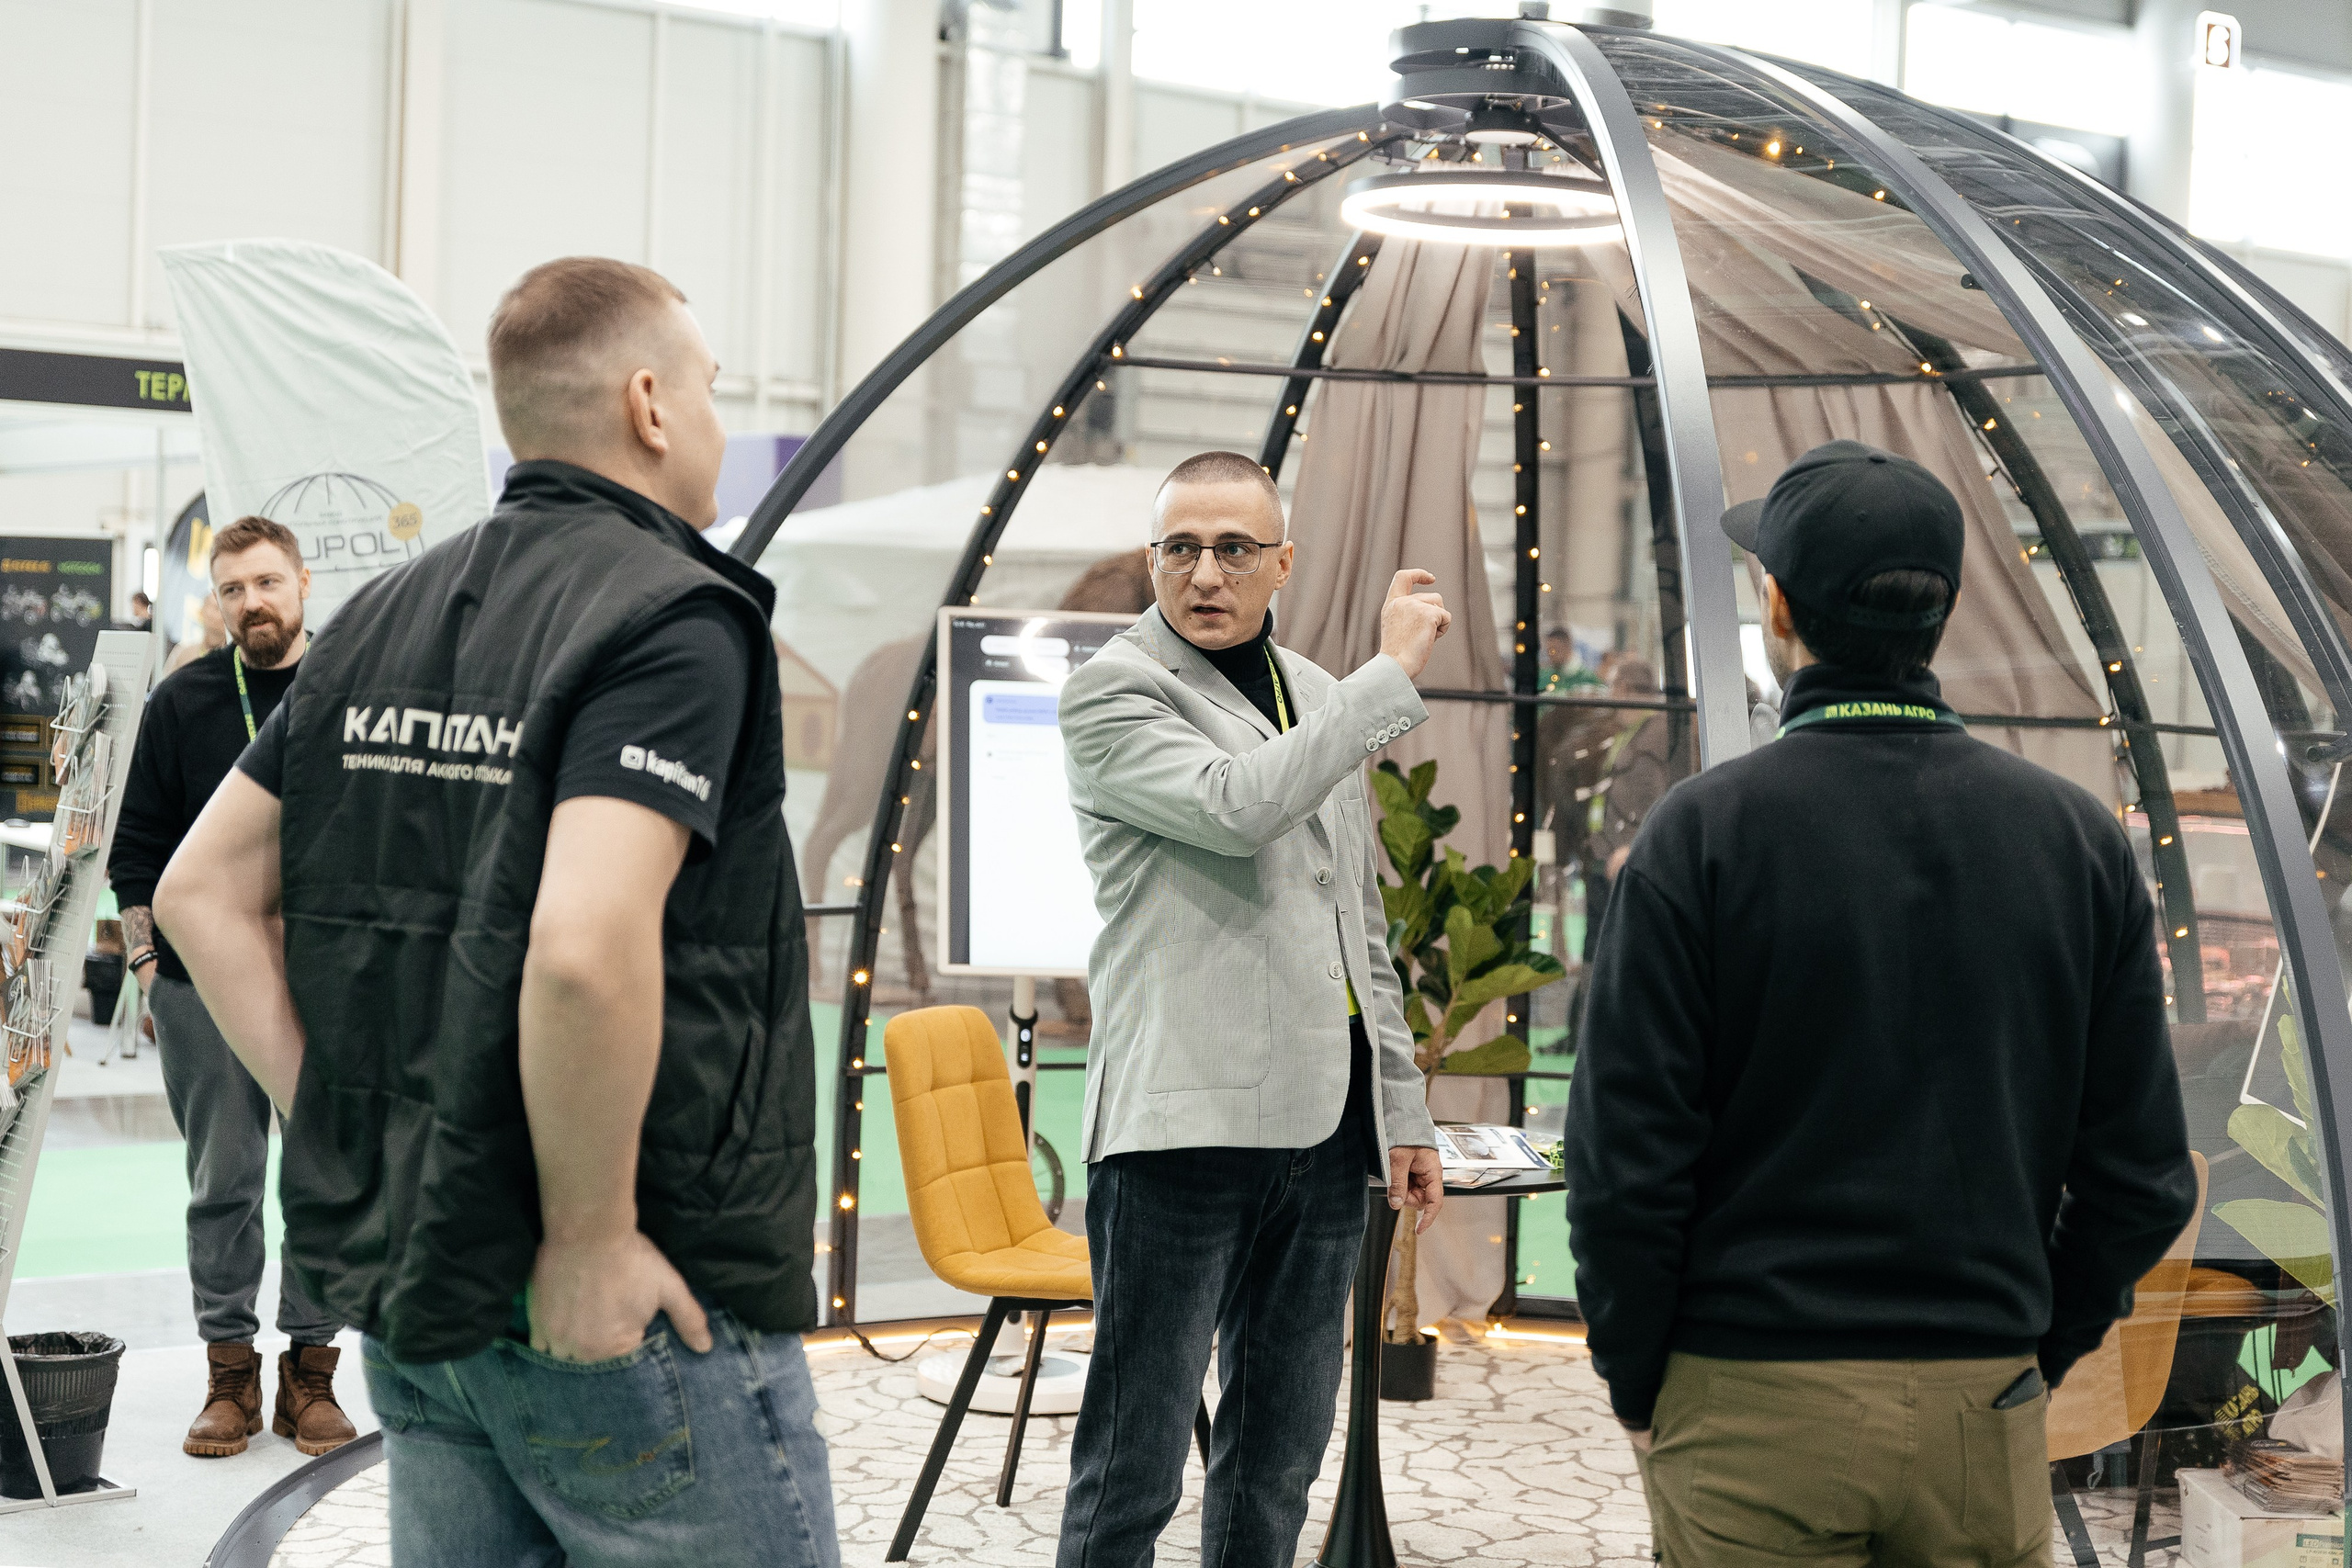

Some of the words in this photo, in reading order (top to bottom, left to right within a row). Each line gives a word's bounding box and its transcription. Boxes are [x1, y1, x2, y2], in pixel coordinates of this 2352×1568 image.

[300, 530, 401, 561] UPOL
[1838, 701, 1903, 718] КАЗАНЬ
[1904, 705, 1936, 721] АГРО
